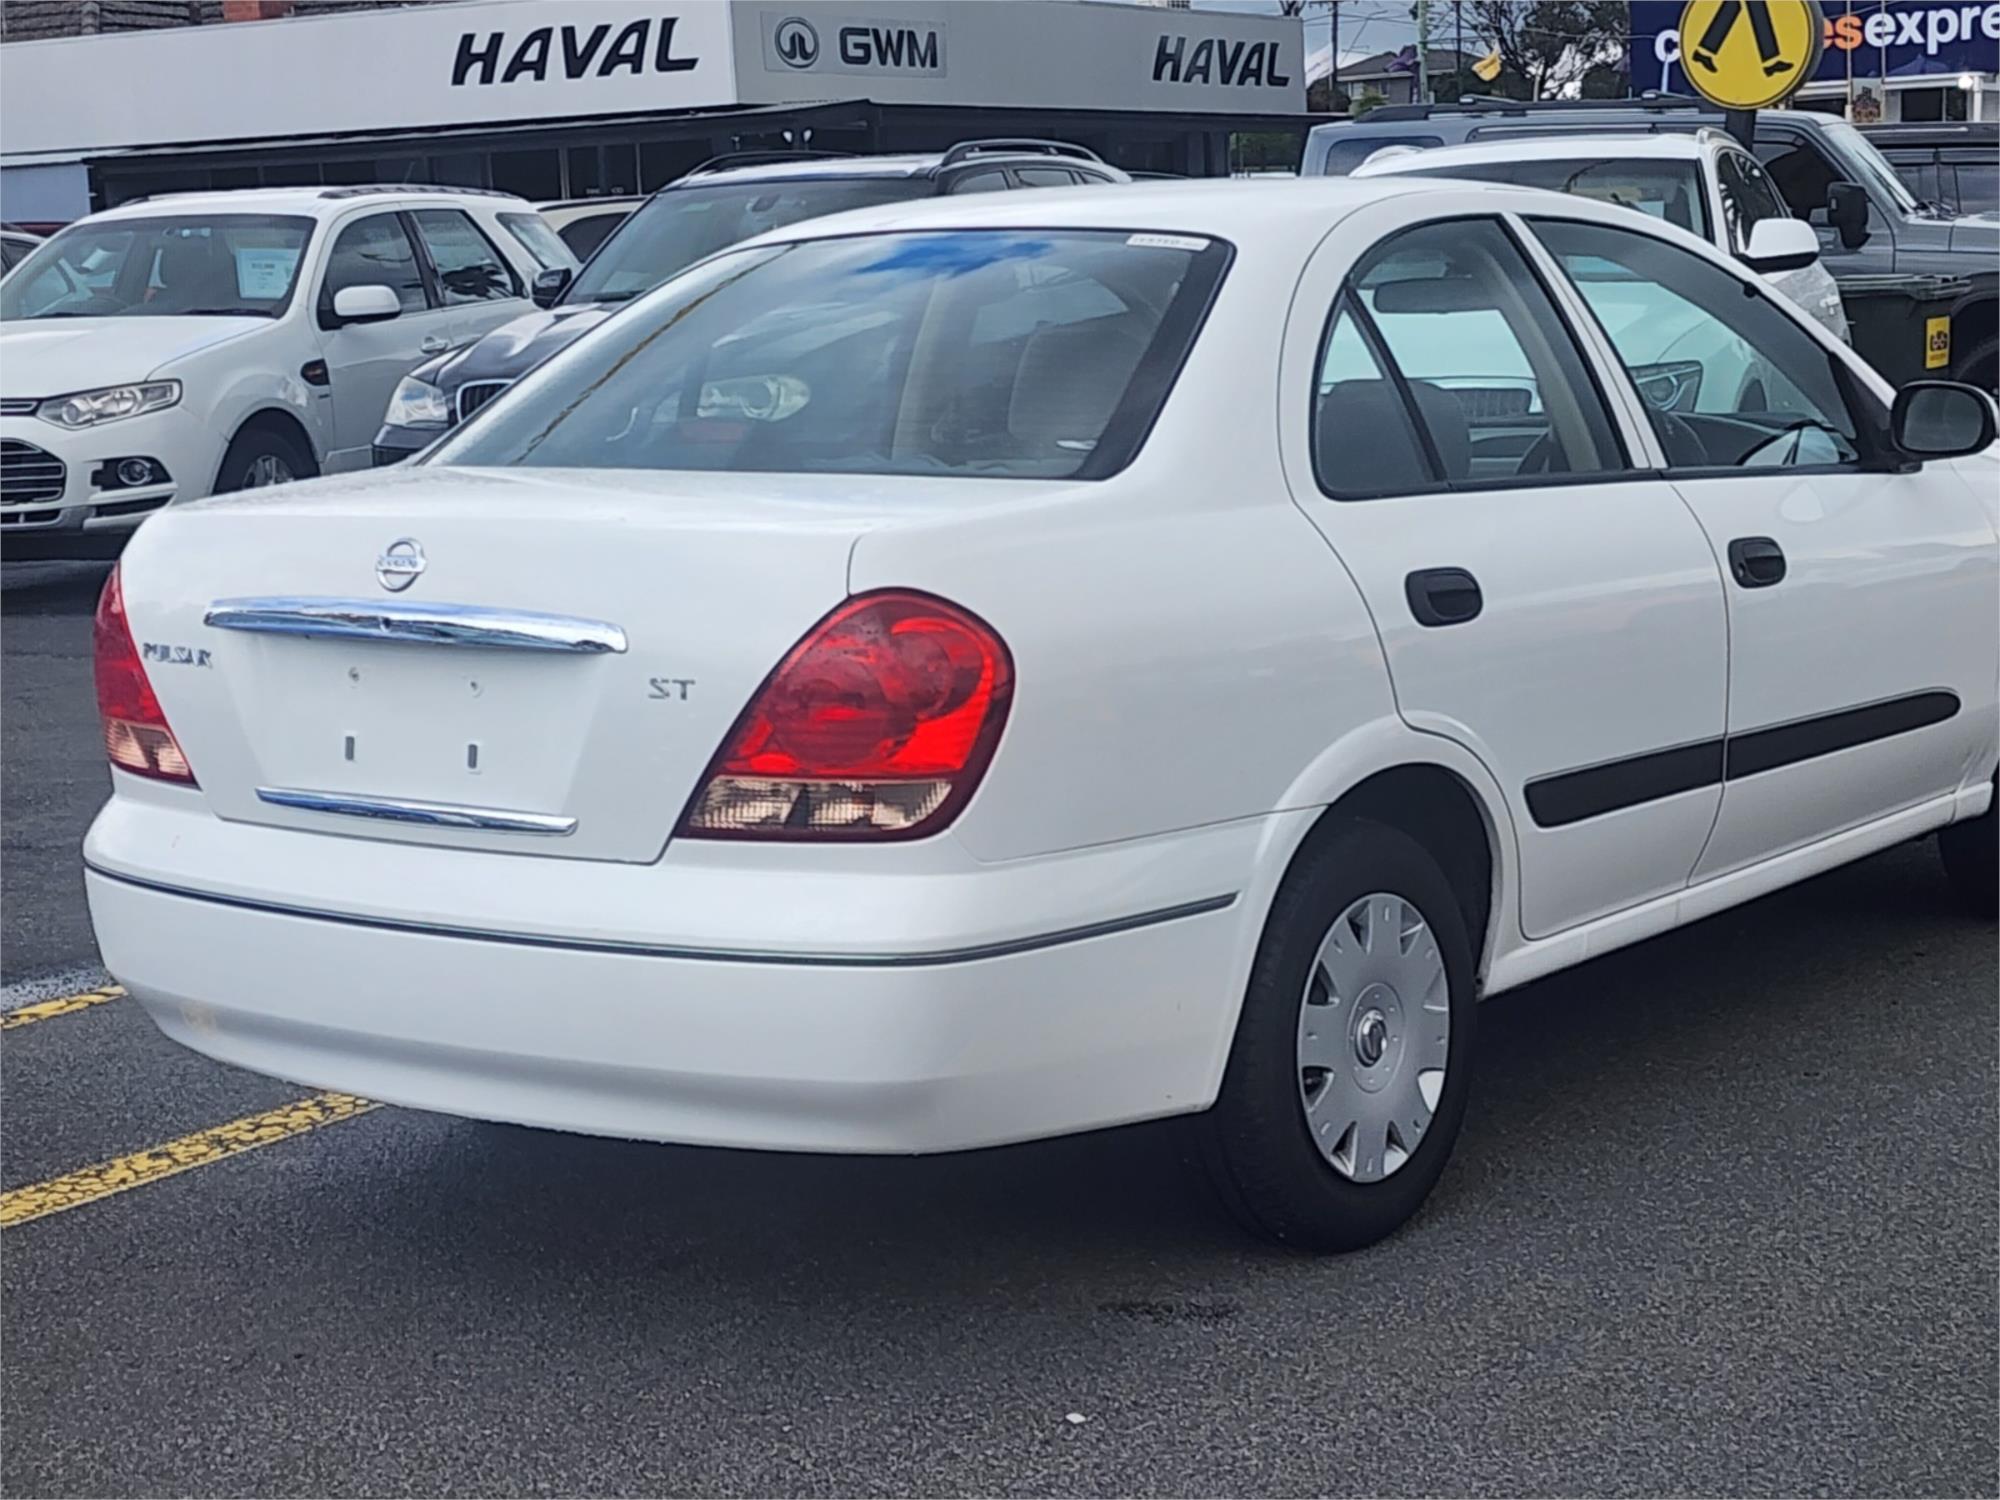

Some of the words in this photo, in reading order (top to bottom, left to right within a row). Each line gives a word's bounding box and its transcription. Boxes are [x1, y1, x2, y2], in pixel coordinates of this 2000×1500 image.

[450, 16, 700, 86] HAVAL
[838, 26, 939, 69] GWM
[1151, 34, 1291, 88] HAVAL
[647, 677, 697, 701] ST
